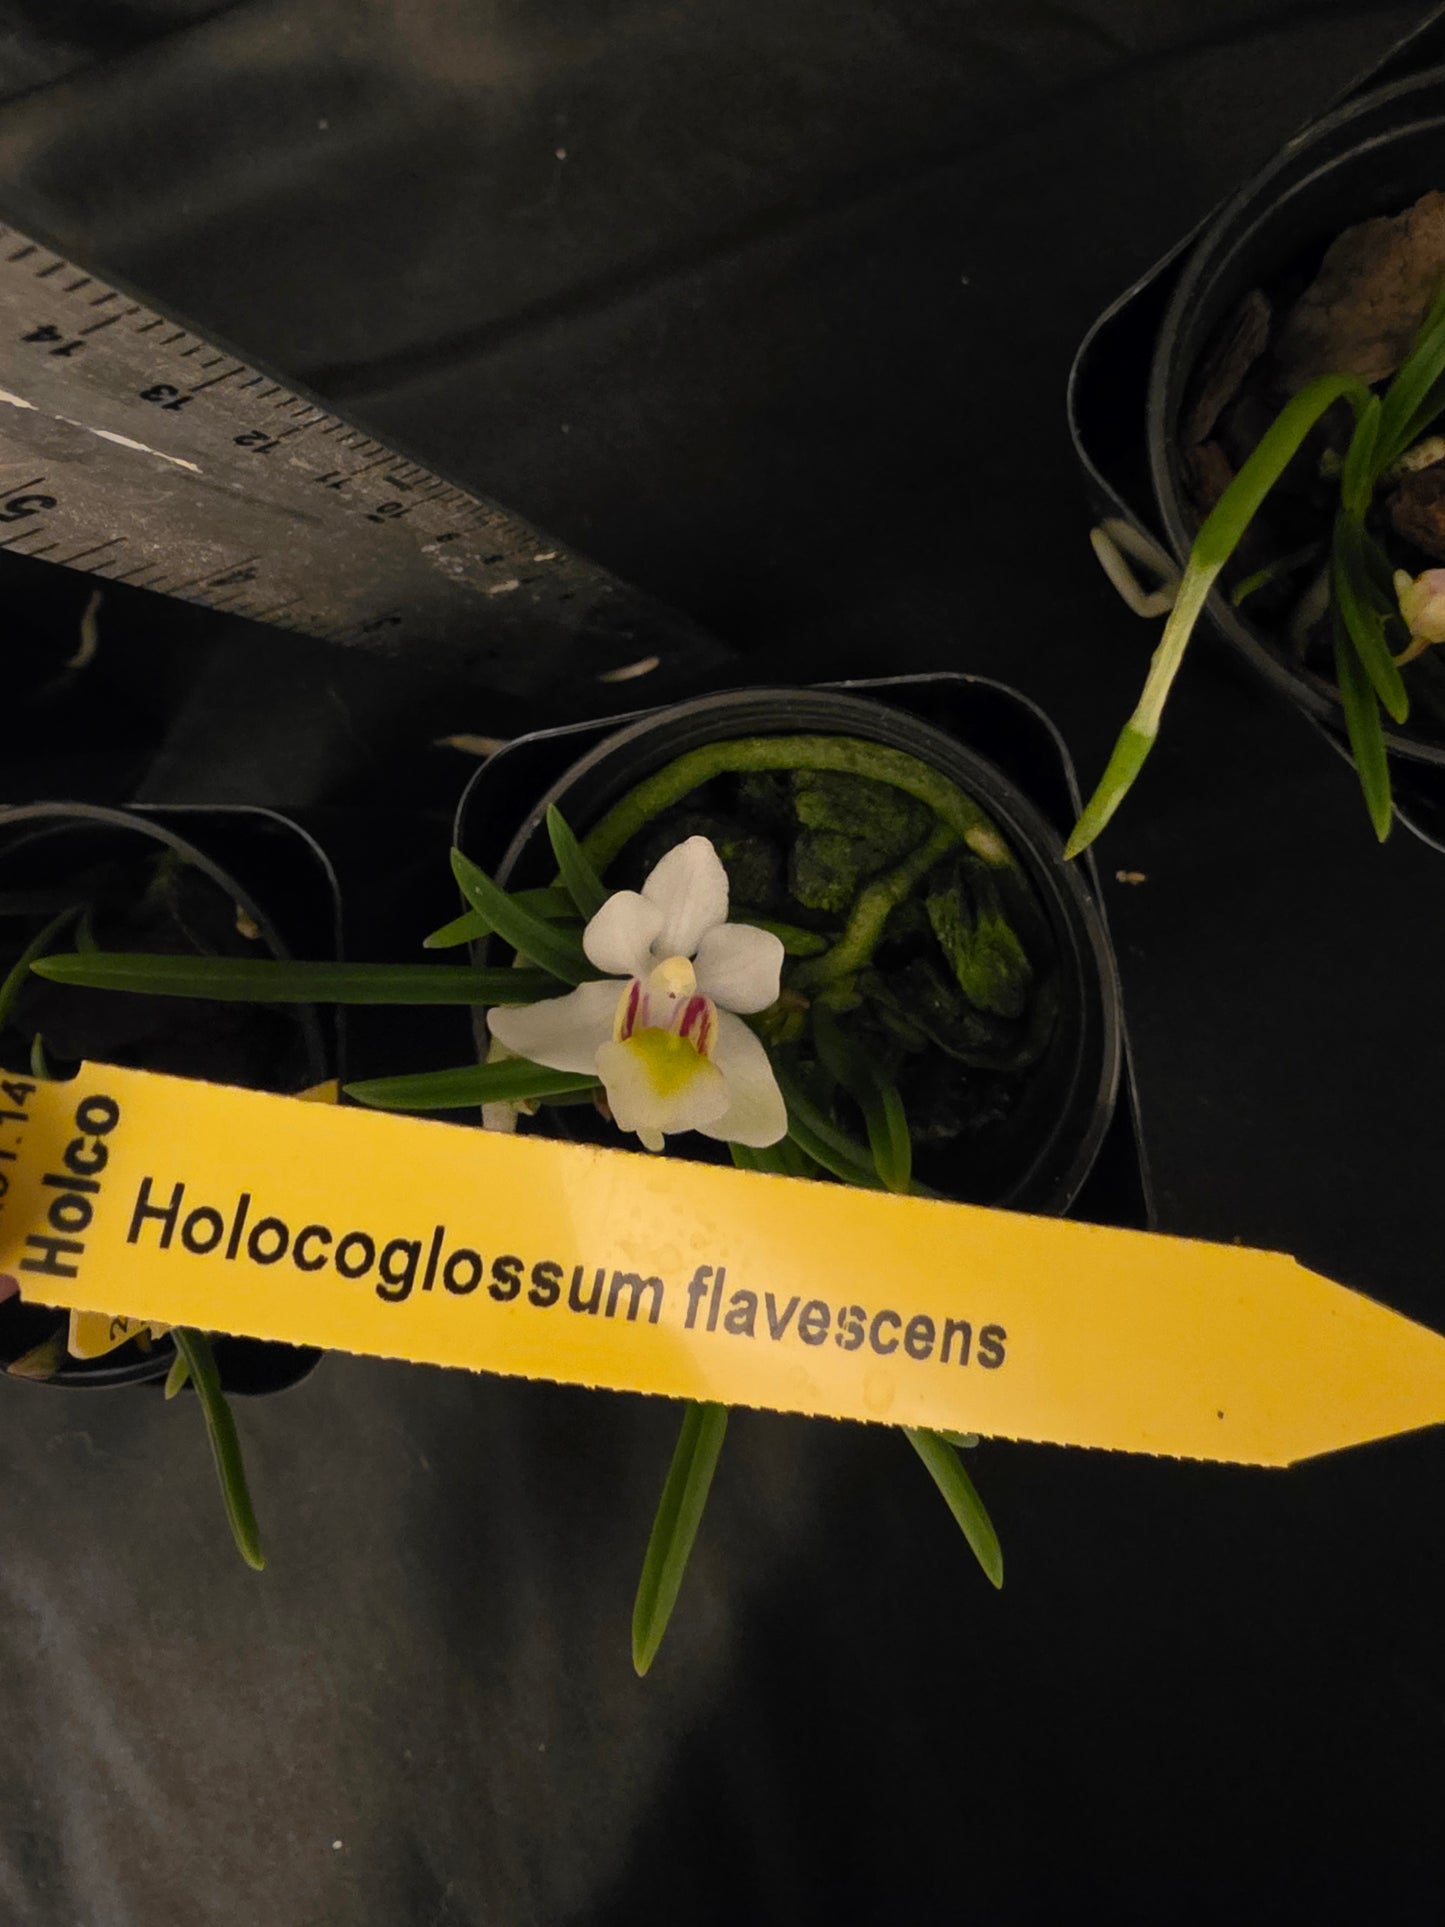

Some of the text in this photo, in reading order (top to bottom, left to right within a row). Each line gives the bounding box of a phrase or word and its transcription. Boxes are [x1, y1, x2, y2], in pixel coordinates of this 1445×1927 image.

[20, 324, 86, 357] 14
[139, 384, 194, 411] 13
[233, 430, 281, 454] 12
[314, 471, 347, 490] 11
[0, 494, 57, 523] 5
[19, 1094, 119, 1278] Holco
[127, 1176, 1009, 1370] Holocoglossum flavescens
